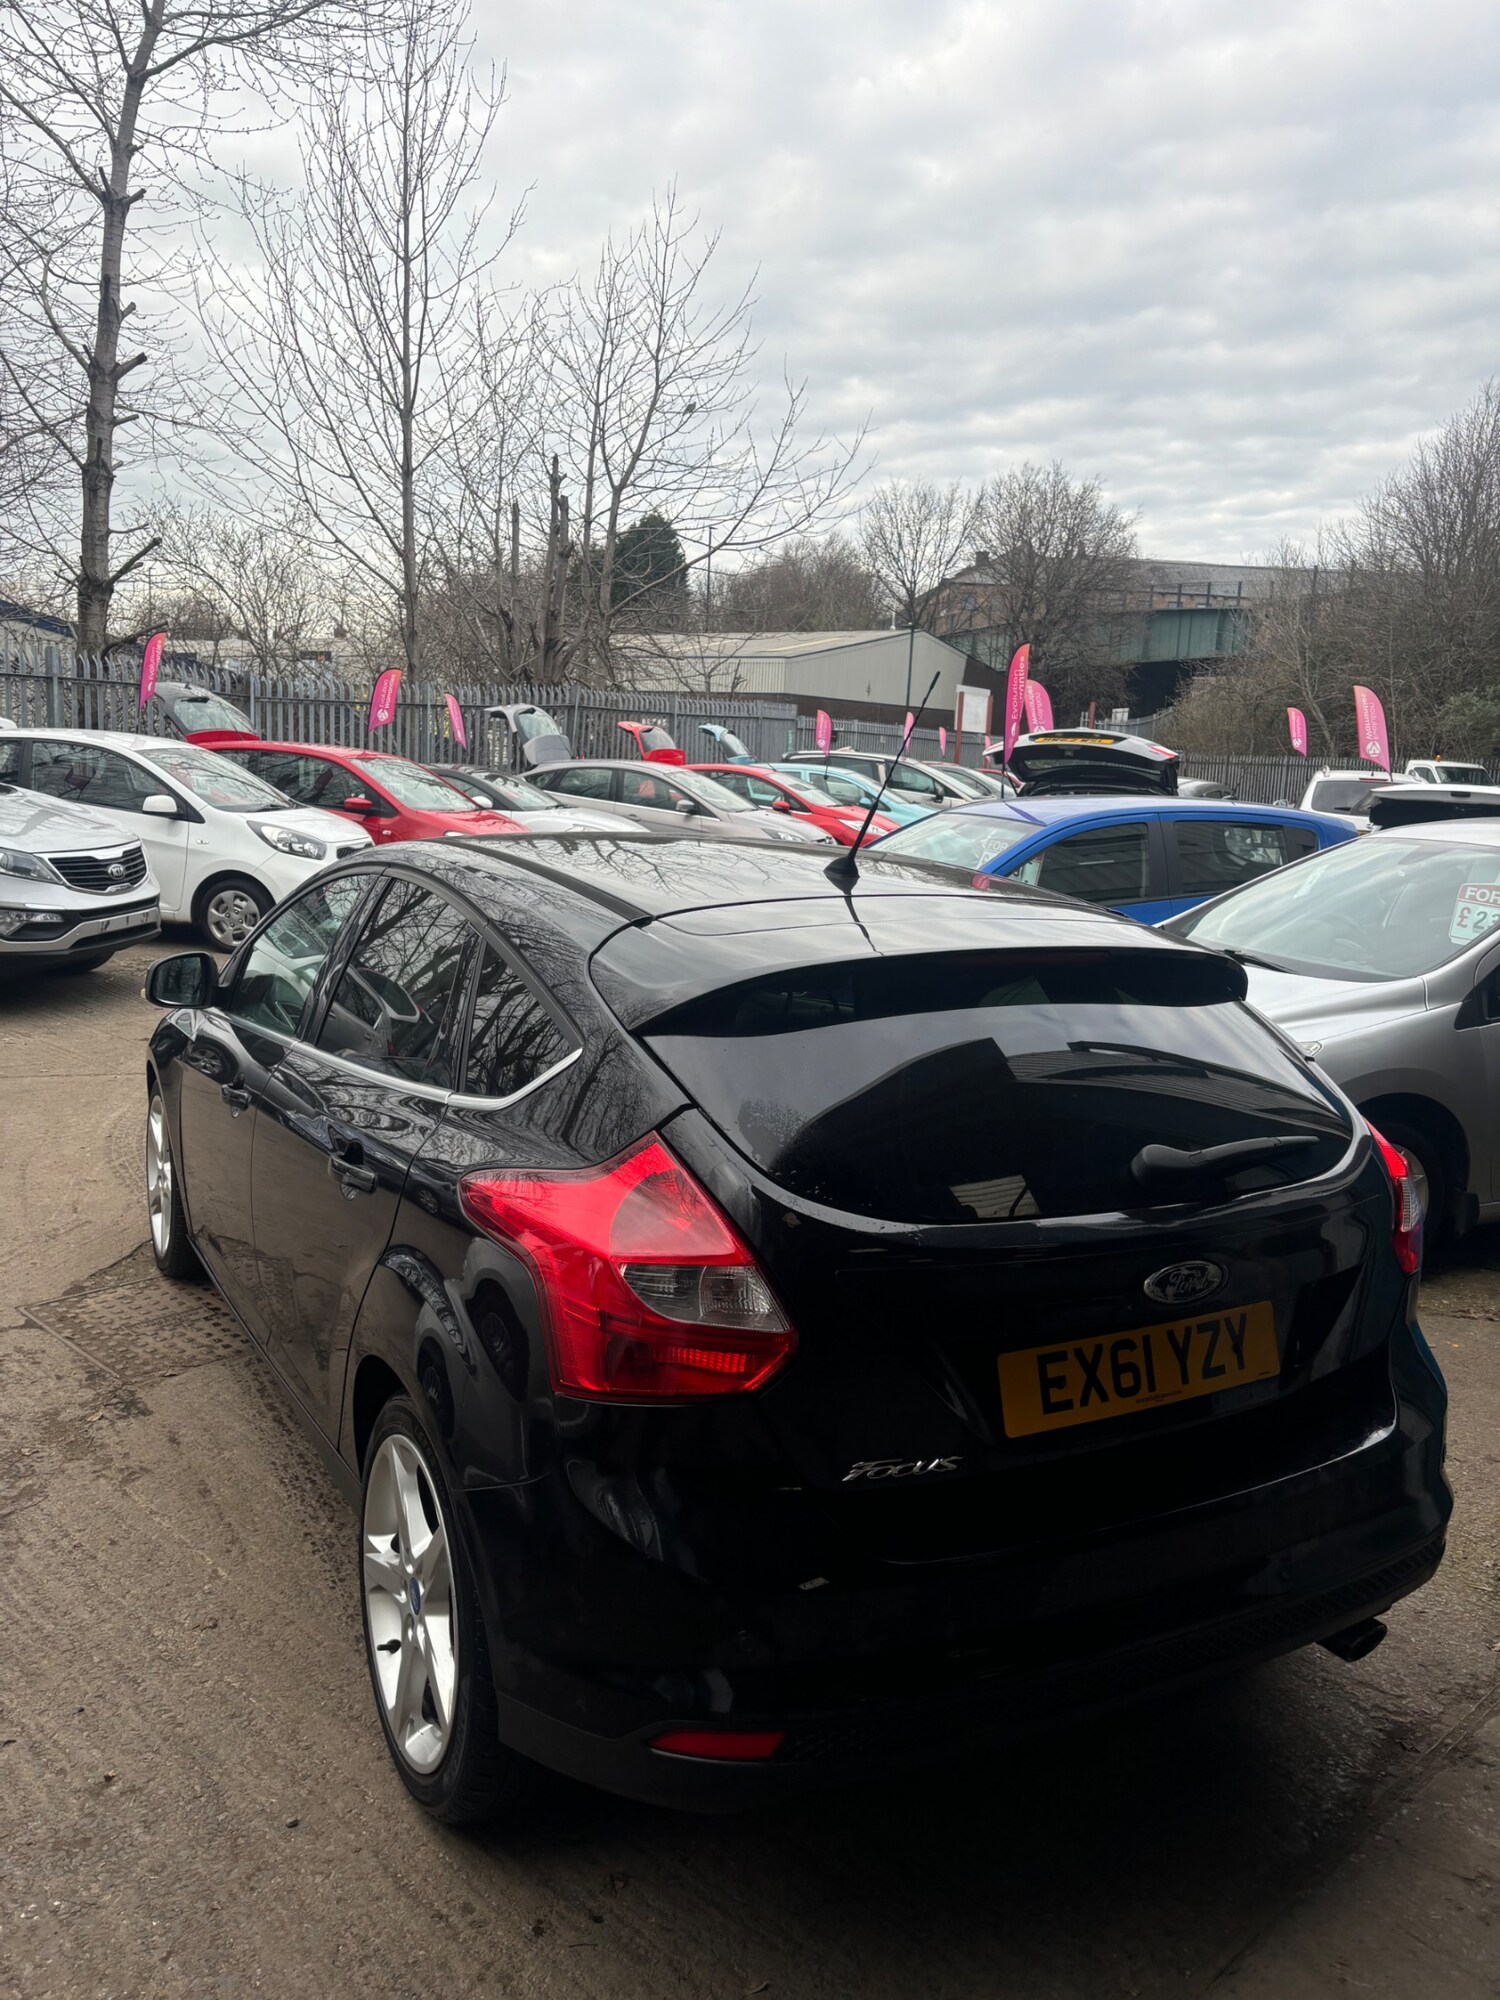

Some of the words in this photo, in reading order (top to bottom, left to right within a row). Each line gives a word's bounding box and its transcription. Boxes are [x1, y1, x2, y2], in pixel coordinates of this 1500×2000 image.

[379, 679, 389, 708] Evolution
[1011, 669, 1019, 720] Evolution
[1037, 1334, 1157, 1415] EX61
[1166, 1312, 1247, 1385] YZY
